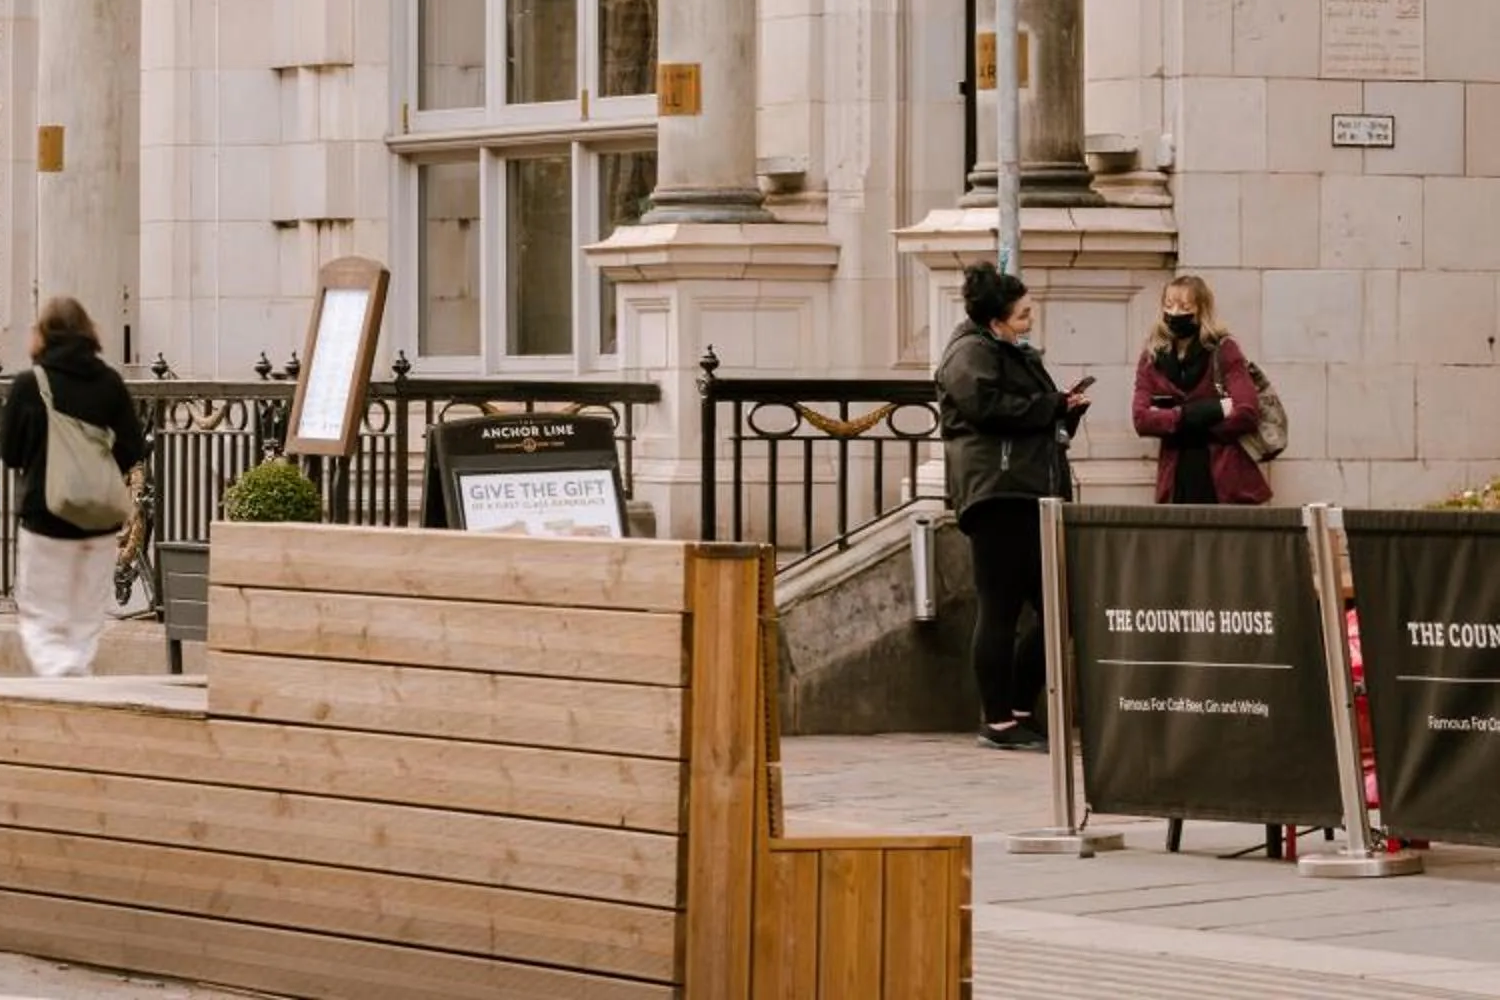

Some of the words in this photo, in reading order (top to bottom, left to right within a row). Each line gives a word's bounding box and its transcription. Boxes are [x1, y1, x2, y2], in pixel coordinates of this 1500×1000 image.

[481, 426, 541, 439] ANCHOR
[543, 424, 575, 436] LINE
[470, 483, 515, 500] GIVE
[519, 482, 558, 498] THE
[563, 479, 606, 496] GIFT
[1105, 609, 1133, 633] THE
[1135, 609, 1216, 634] COUNTING
[1219, 611, 1274, 635] HOUSE
[1407, 621, 1445, 646] THE
[1119, 697, 1150, 712] Famous
[1151, 697, 1167, 712] For
[1205, 700, 1221, 714] Gin
[1221, 701, 1238, 714] and
[1239, 701, 1270, 718] Whisky
[1428, 715, 1470, 730] Famous
[1471, 716, 1487, 732] For
